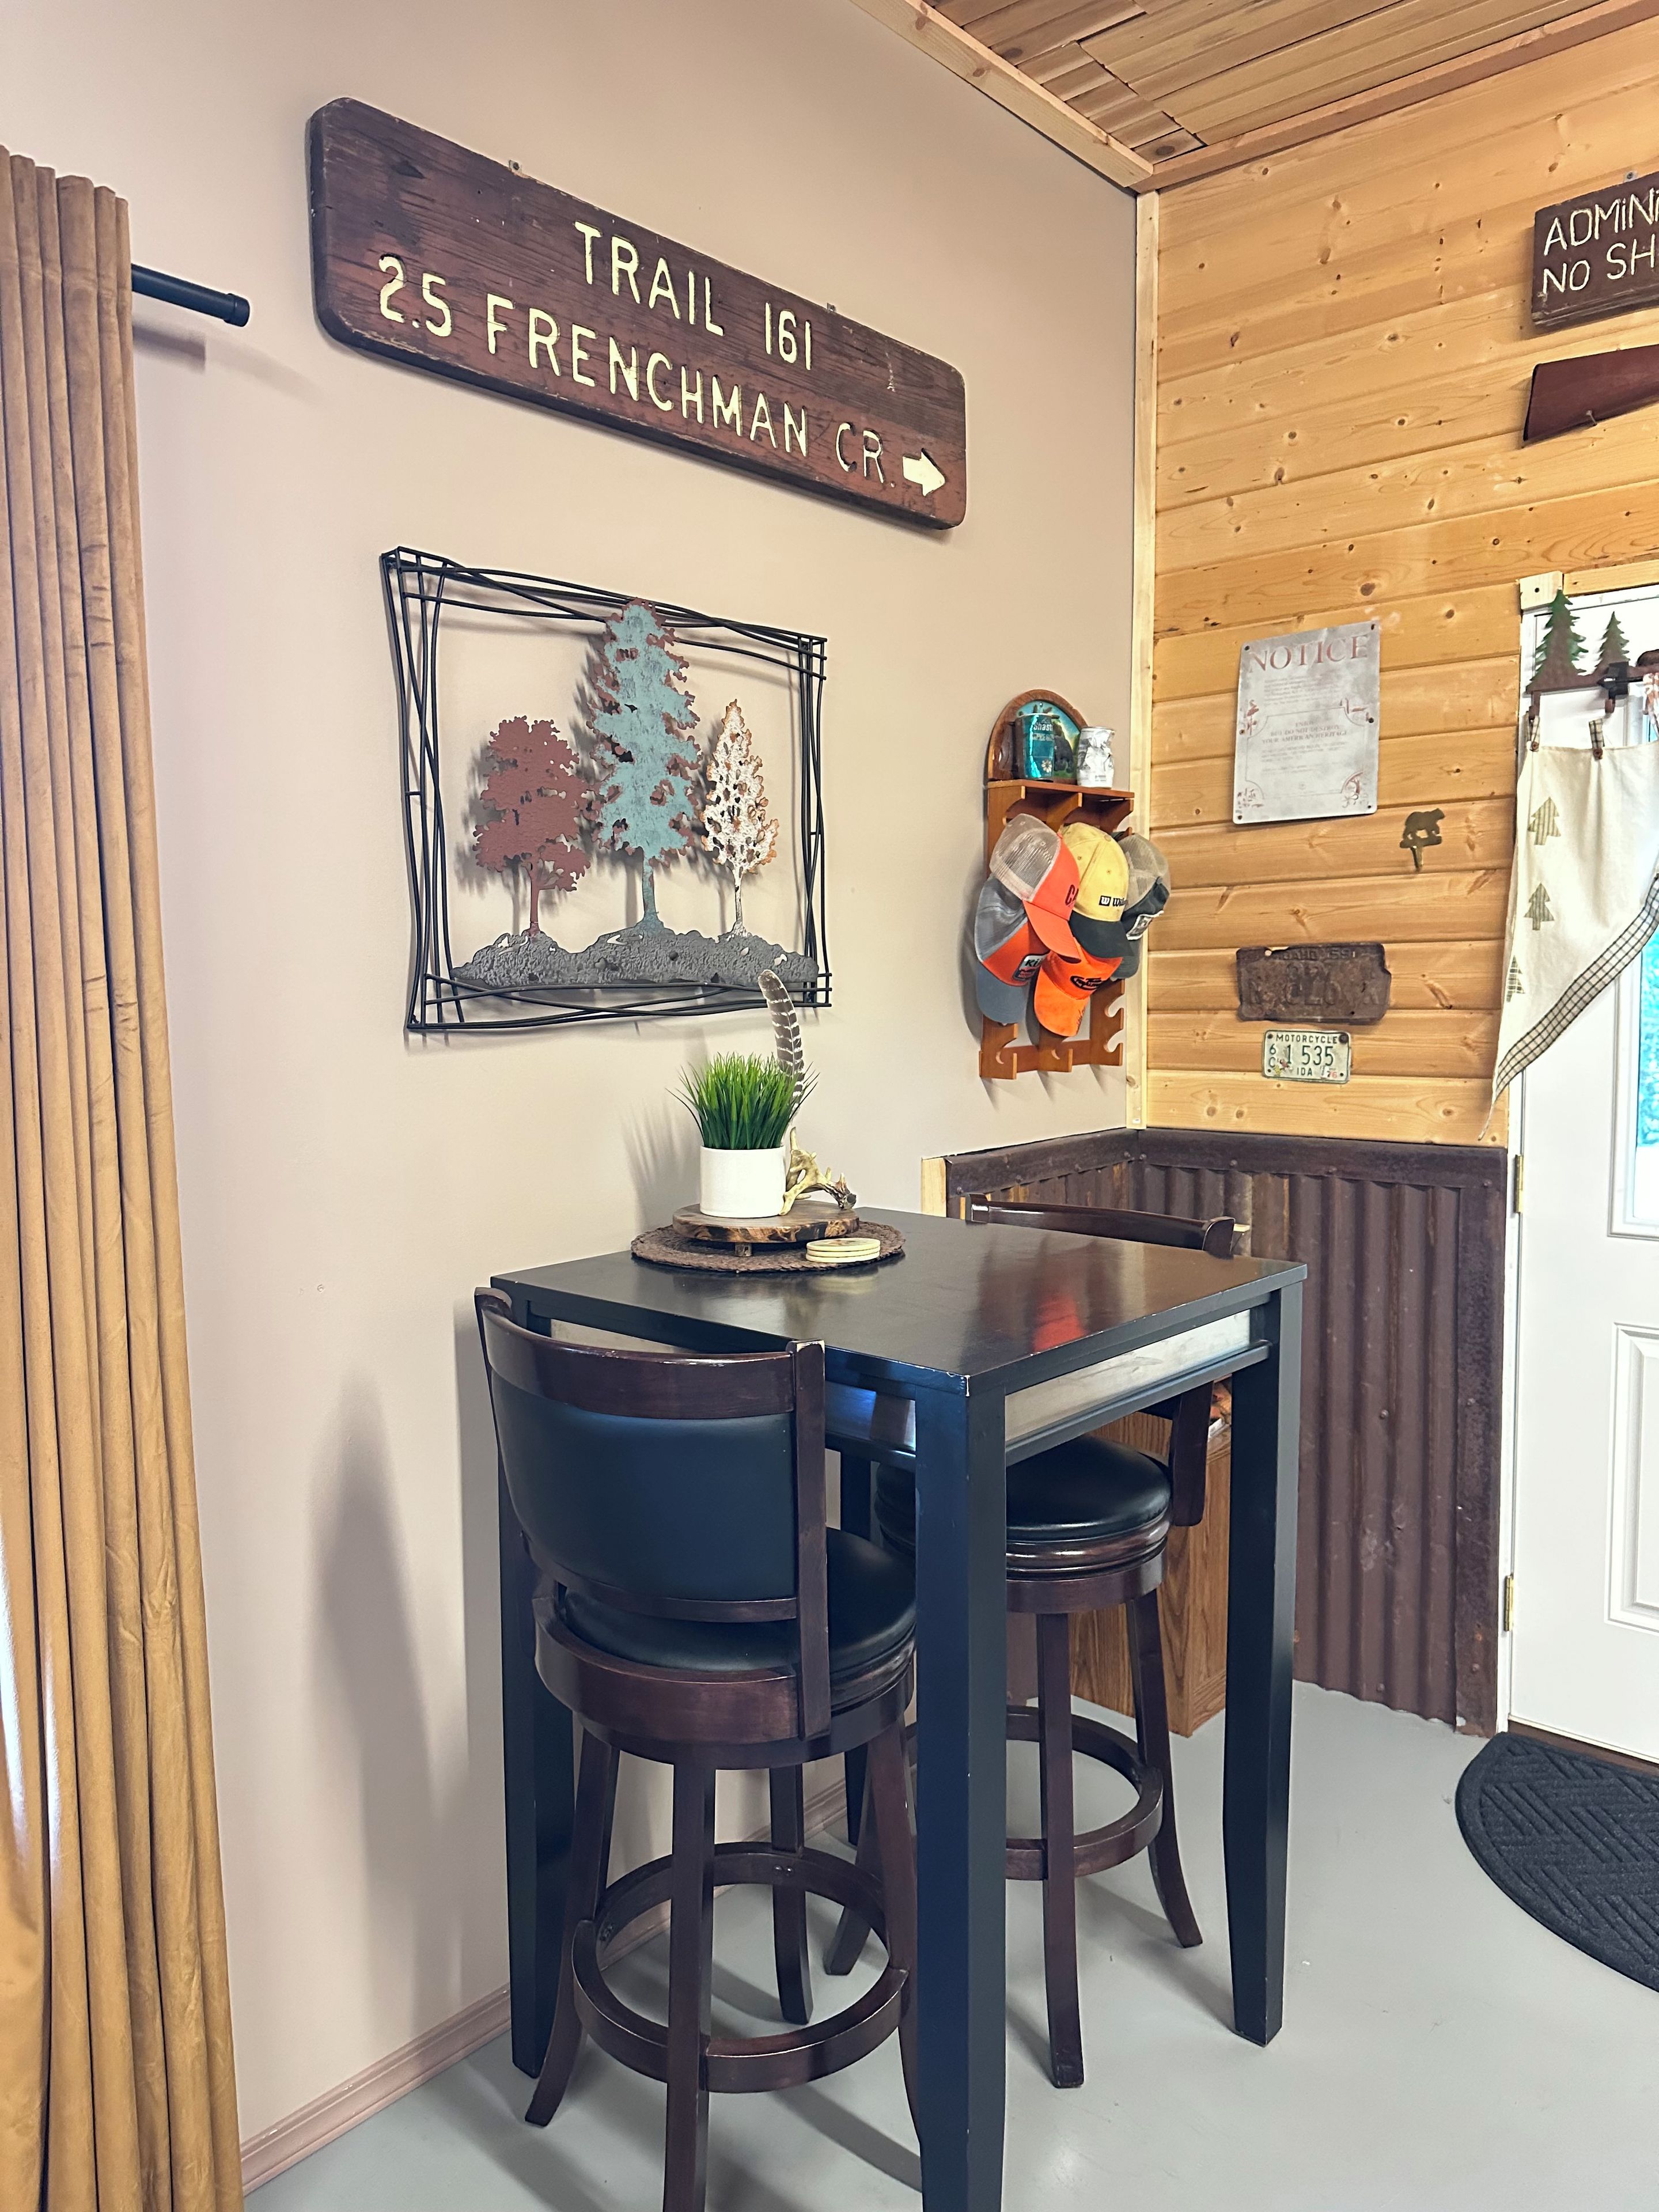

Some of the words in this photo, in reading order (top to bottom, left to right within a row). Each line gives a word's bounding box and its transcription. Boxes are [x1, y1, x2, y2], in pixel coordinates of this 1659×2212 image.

[1543, 260, 1590, 294] NO
[1606, 233, 1656, 280] SH
[573, 220, 725, 336] TRAIL
[765, 301, 812, 371] 161
[378, 252, 452, 337] 2.5
[487, 293, 808, 457] FRENCHMAN
[835, 421, 896, 488] CR.
[1248, 634, 1369, 673] NOTICE
[1276, 1034, 1338, 1044] MOTORCYCLE
[1302, 1045, 1334, 1066] 535
[1297, 1067, 1313, 1076] IDA
